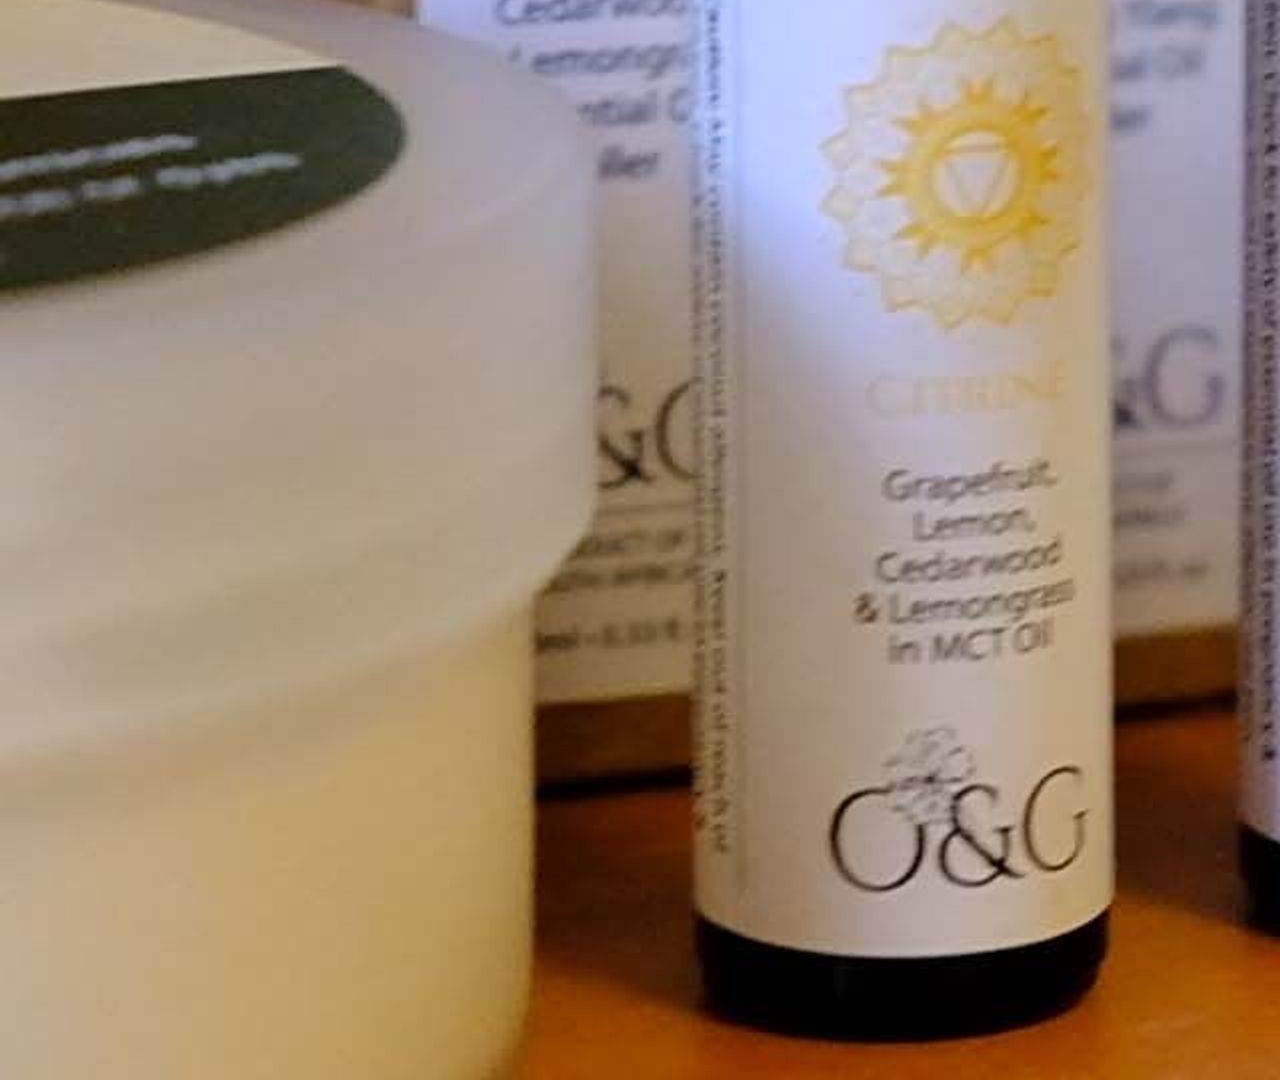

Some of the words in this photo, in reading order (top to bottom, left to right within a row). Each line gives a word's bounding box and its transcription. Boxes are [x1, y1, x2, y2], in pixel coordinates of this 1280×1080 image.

[875, 534, 1063, 584] Cedarwood
[854, 591, 879, 625] &
[887, 633, 921, 665] in
[928, 626, 1008, 663] MCT
[829, 765, 1089, 893] O&G
